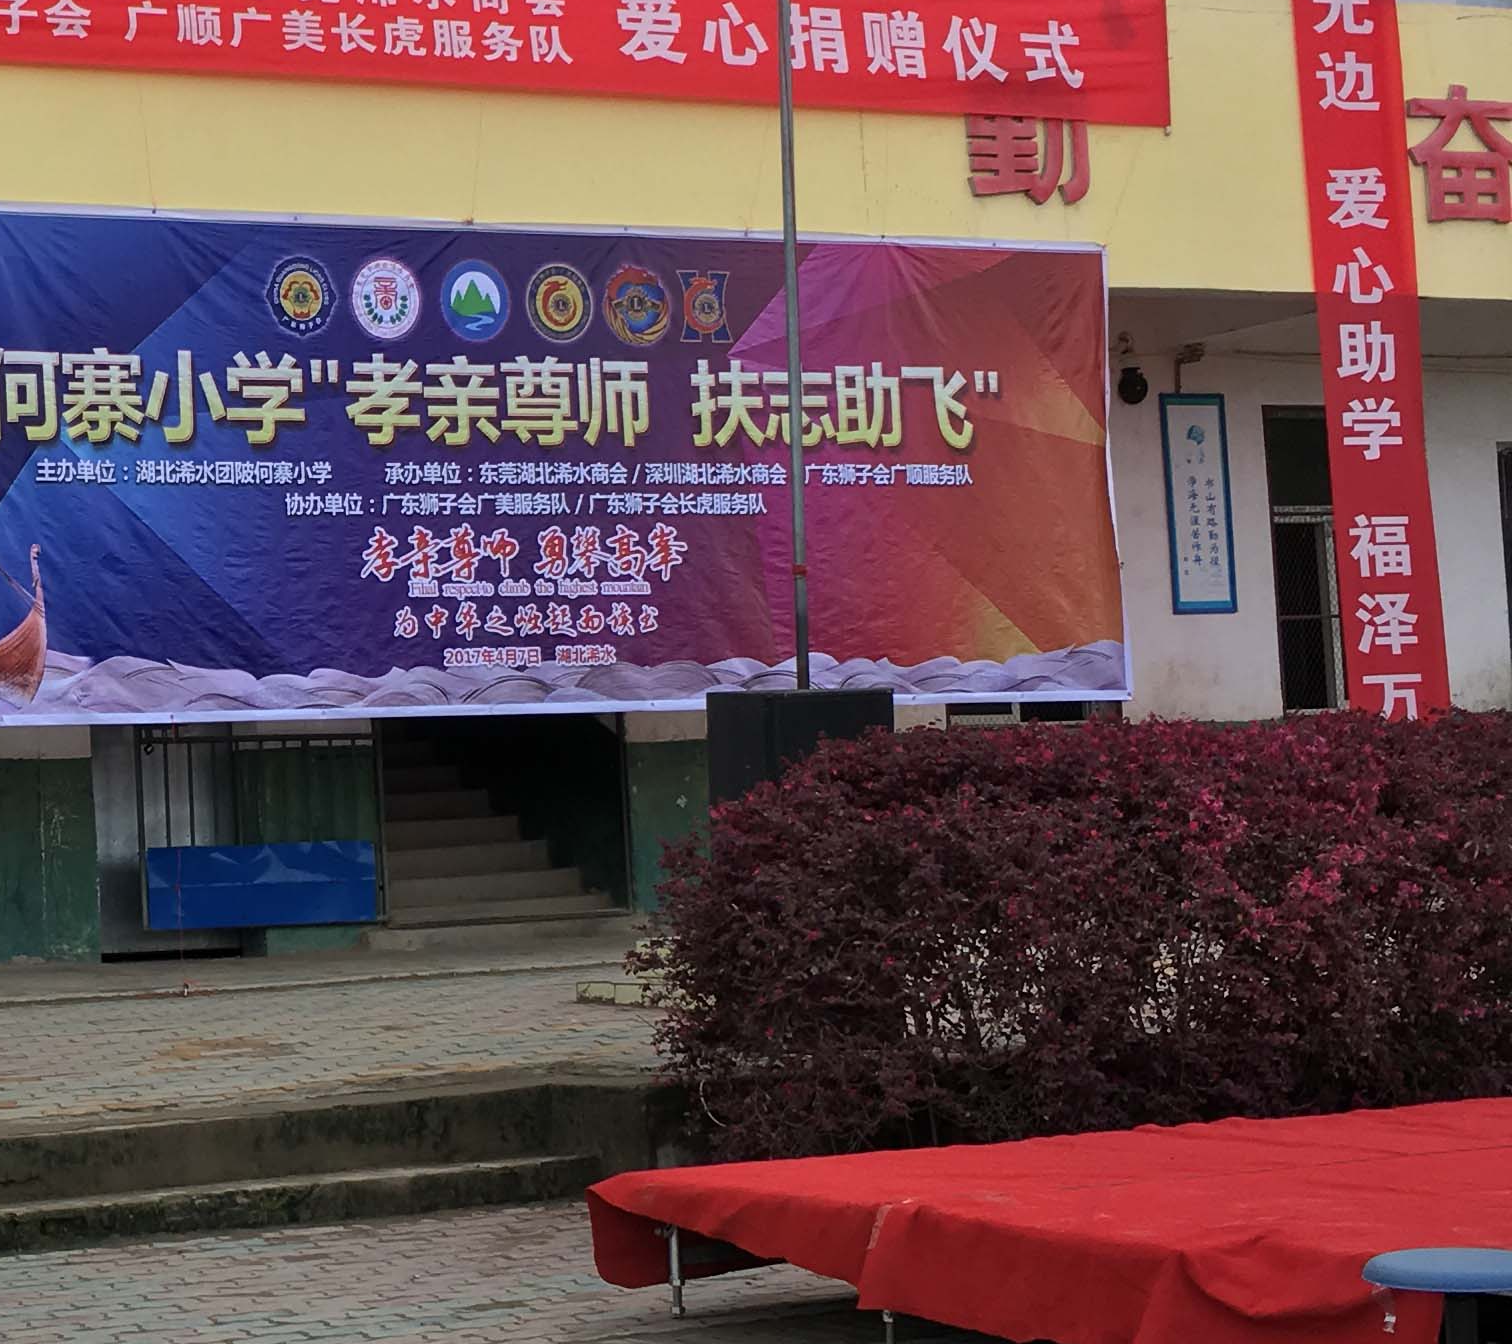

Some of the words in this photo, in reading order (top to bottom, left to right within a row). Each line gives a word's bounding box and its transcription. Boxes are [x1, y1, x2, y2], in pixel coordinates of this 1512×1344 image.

[124, 1, 574, 65] 广顺广美长虎服务队
[1406, 84, 1512, 224] 奋
[1326, 168, 1403, 460] 爱心助学
[443, 647, 542, 667] 2017年4月7日
[555, 645, 616, 665] 湖北浠水
